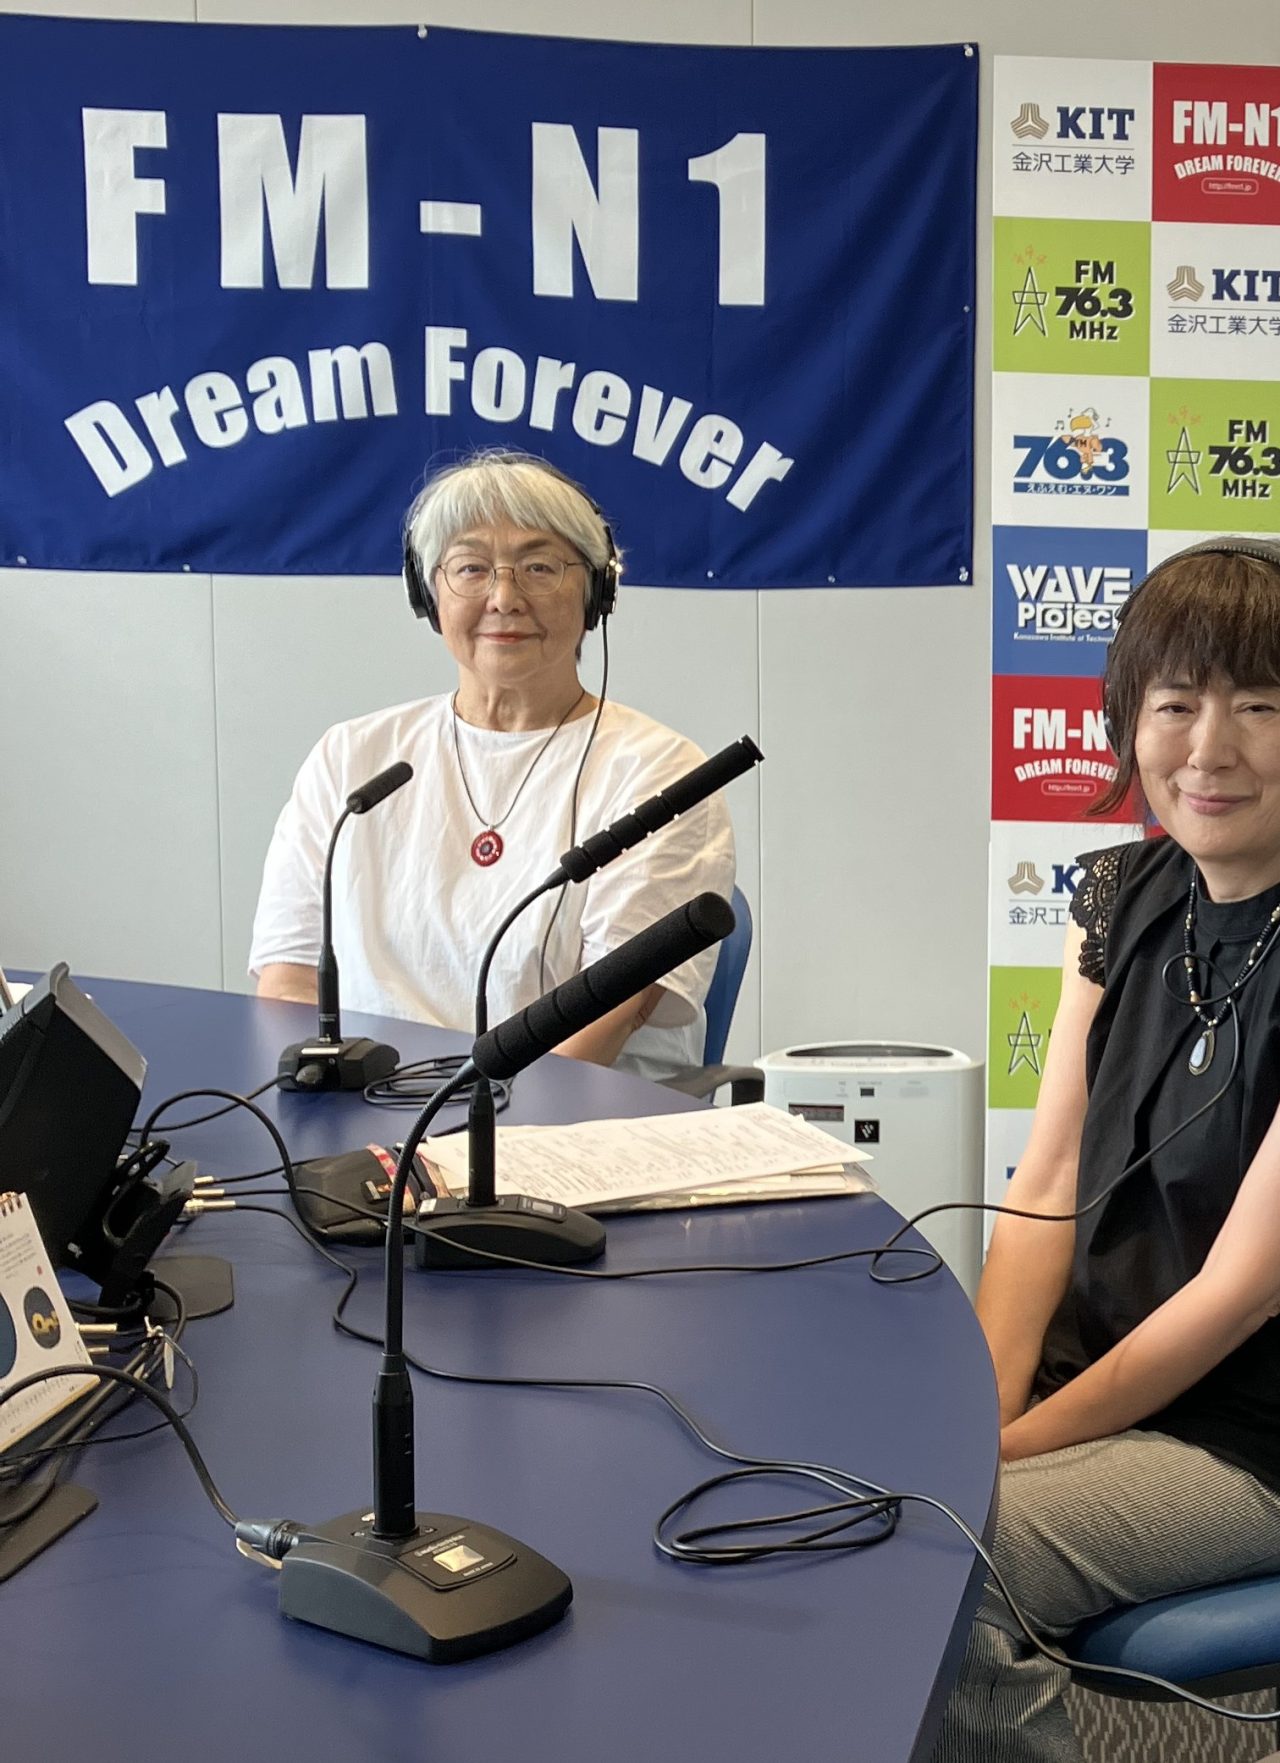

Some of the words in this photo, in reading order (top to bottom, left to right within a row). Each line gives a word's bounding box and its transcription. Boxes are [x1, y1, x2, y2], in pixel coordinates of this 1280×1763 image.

[1057, 106, 1135, 141] KIT
[1012, 151, 1135, 175] 金沢工業大学
[1174, 155, 1224, 180] DREAM
[1073, 260, 1115, 285] FM
[1055, 286, 1135, 318] 76.3
[1068, 321, 1119, 341] MHz
[64, 341, 399, 498] Dream
[425, 326, 795, 513] Forever
[1228, 420, 1267, 444] FM
[1222, 479, 1272, 499] MHz
[1006, 564, 1131, 603] WAVE
[1013, 707, 1108, 751] FM-N
[1014, 758, 1063, 782] DREAM
[1008, 906, 1067, 926] 金沢工
